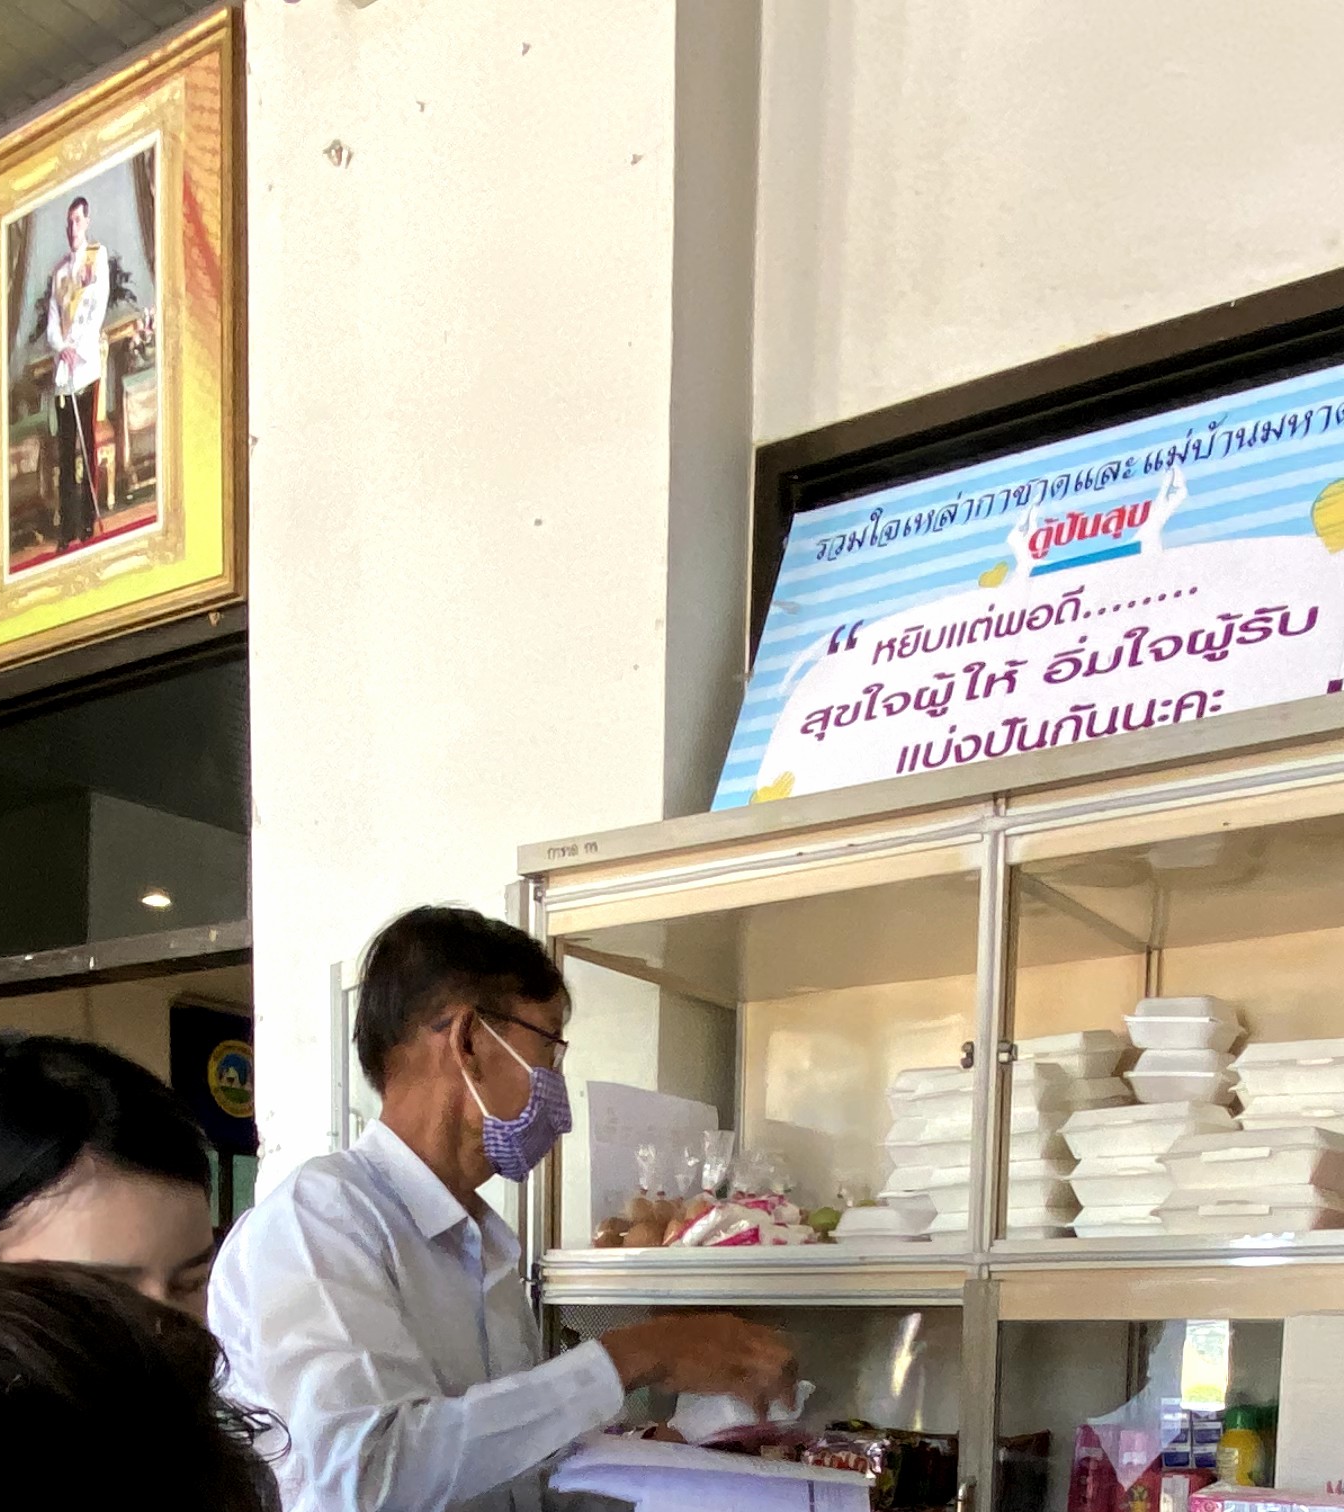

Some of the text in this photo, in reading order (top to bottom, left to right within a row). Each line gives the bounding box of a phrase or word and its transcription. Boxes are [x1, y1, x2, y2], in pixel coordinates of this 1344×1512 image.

[1028, 500, 1153, 560] ตู้ปันสุข
[1043, 604, 1320, 687] อิ่มใจผู้รับ
[896, 688, 1225, 775] แบ่งปันกันนะคะ
